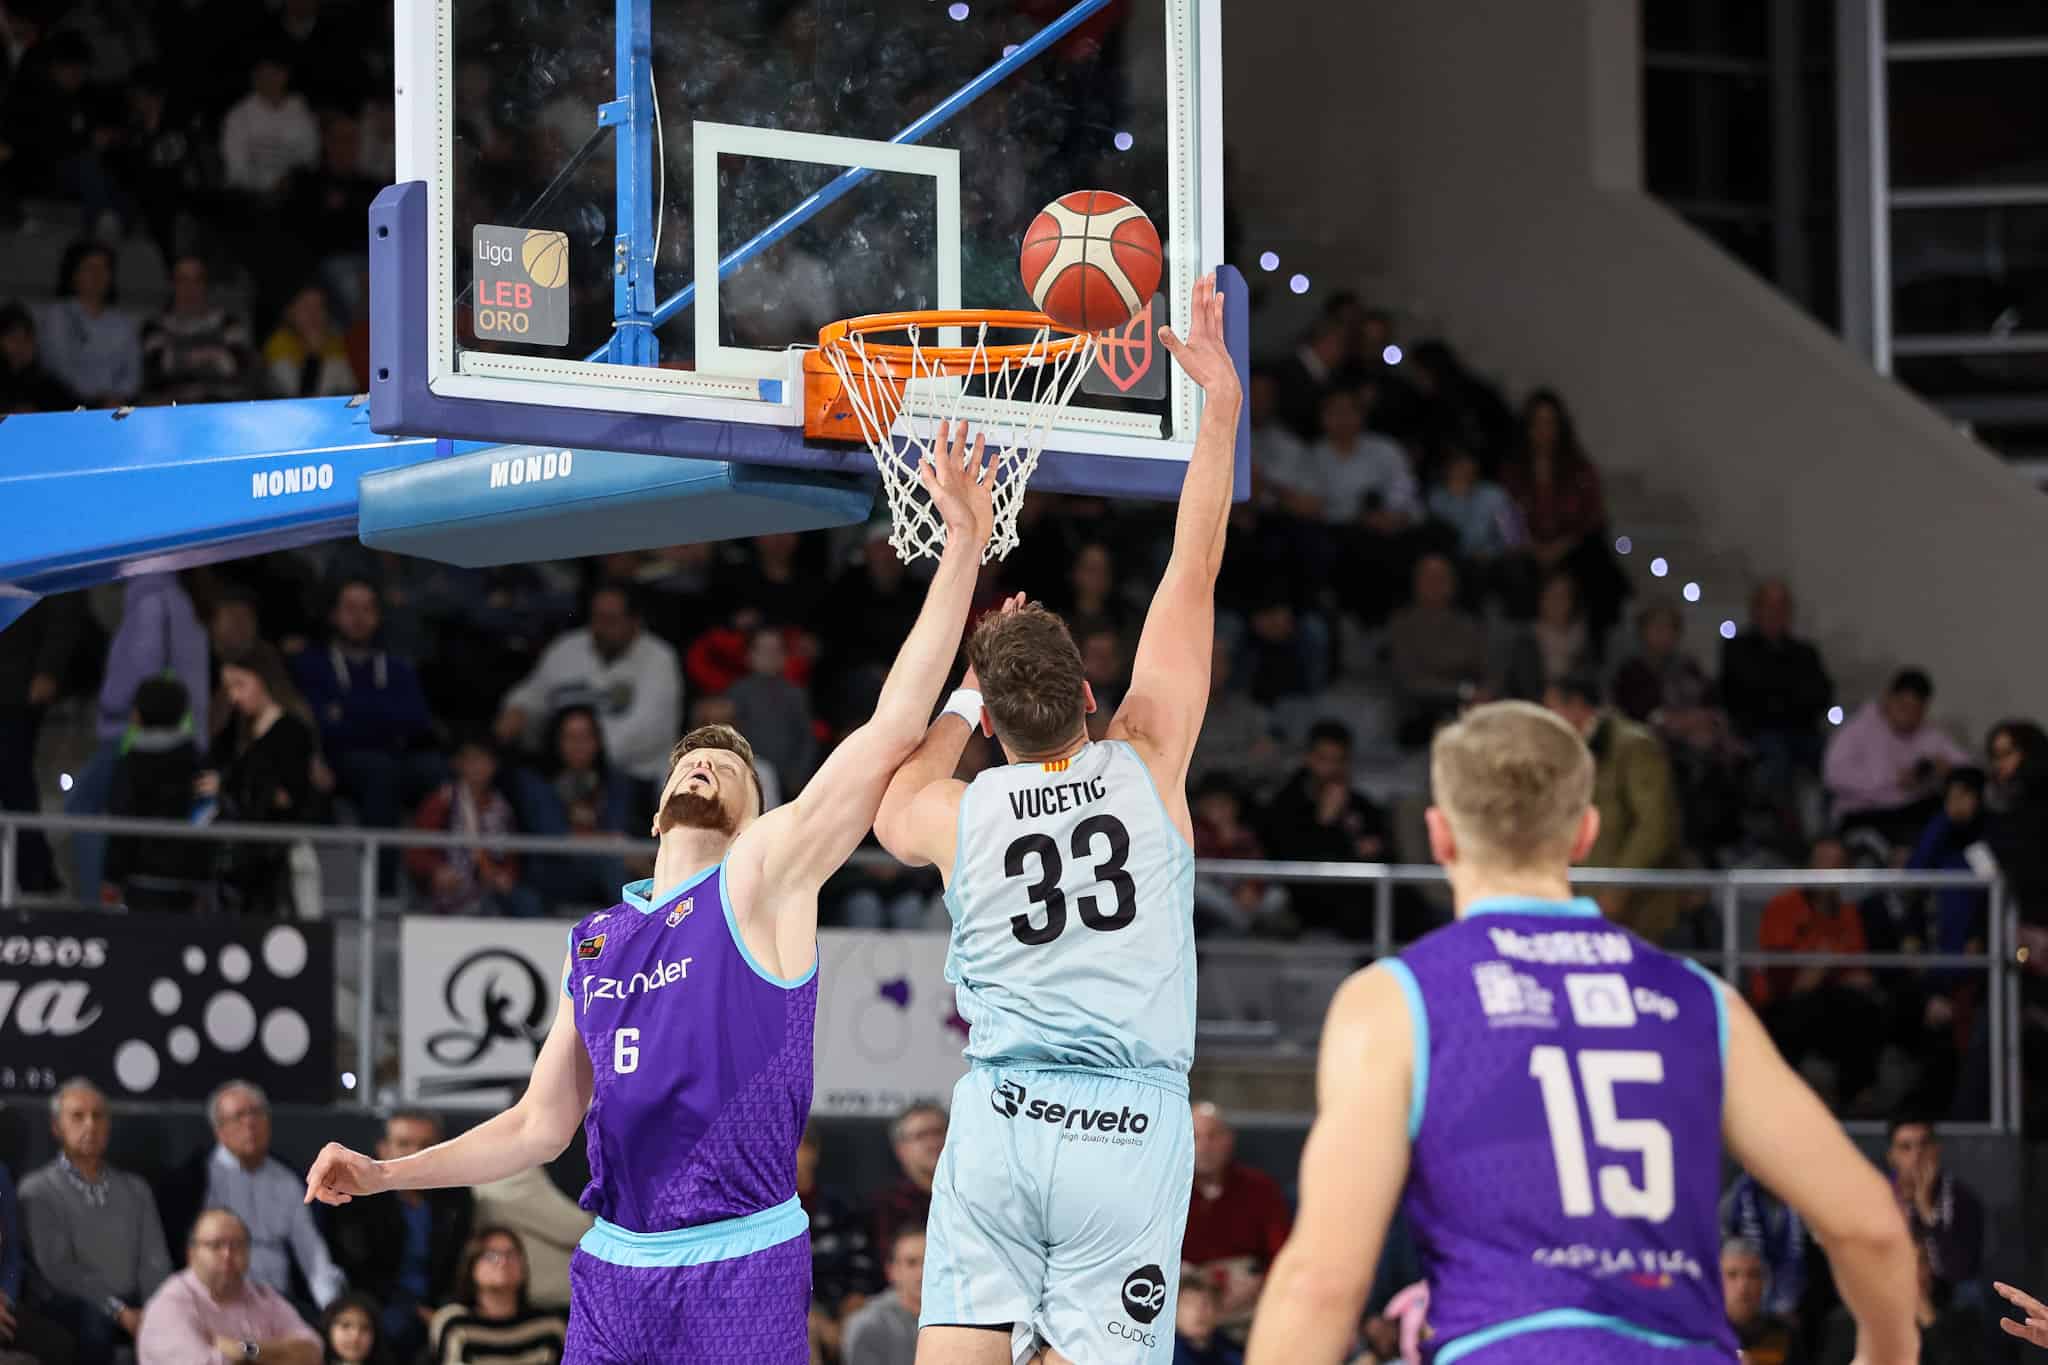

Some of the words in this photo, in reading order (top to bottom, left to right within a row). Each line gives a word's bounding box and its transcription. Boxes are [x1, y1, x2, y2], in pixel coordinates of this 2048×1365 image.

[479, 239, 513, 266] Liga
[479, 279, 533, 310] LEB
[479, 308, 530, 334] ORO
[252, 463, 334, 499] MONDO
[490, 450, 573, 488] MONDO
[1008, 775, 1107, 820] VUCETIC
[1004, 813, 1136, 946] 33
[0, 935, 108, 969] esos
[593, 956, 693, 1000] zunder
[613, 1027, 641, 1075] 6
[1025, 1098, 1149, 1134] serveto
[1528, 1044, 1676, 1224] 15
[1081, 1133, 1109, 1145] Quality
[1112, 1134, 1144, 1147] Logistics
